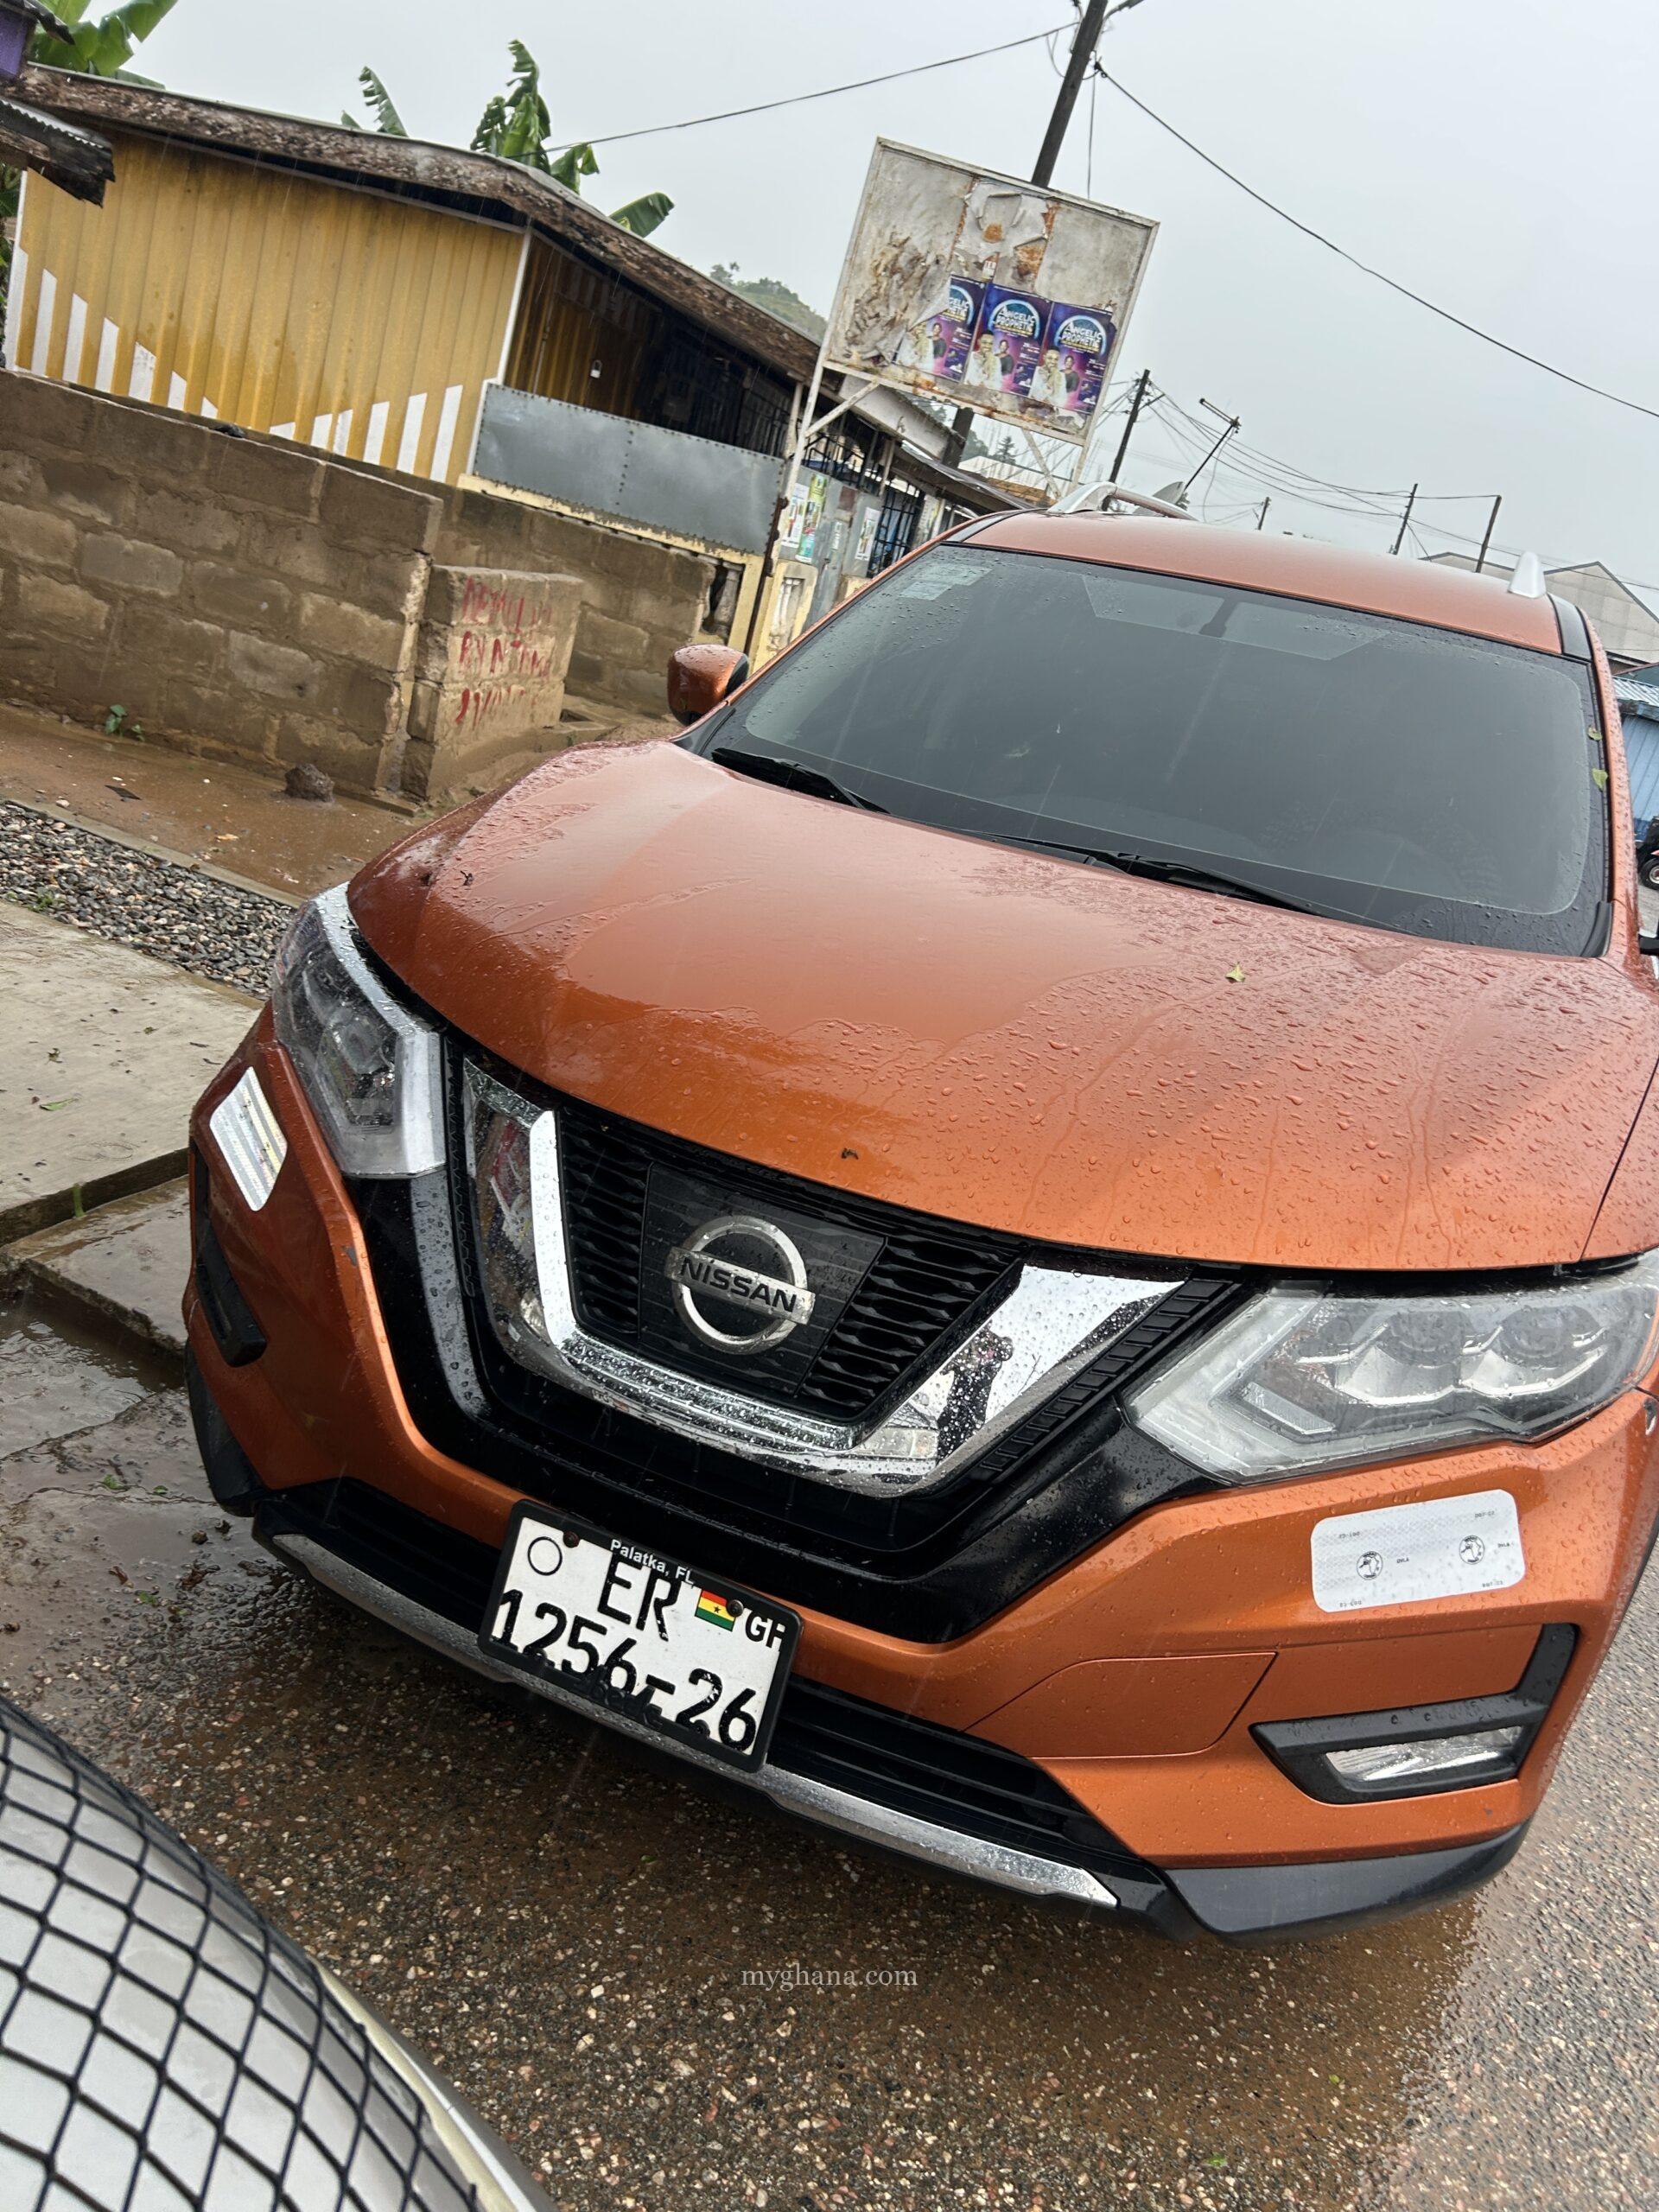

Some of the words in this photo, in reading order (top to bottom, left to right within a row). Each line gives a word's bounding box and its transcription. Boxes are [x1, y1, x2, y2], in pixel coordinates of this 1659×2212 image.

[997, 305, 1035, 323] ANGELIC
[1062, 321, 1102, 340] ANGELIC
[679, 1257, 797, 1313] NISSAN
[610, 1539, 670, 1577] Palatka,
[676, 1566, 695, 1585] FL
[598, 1553, 682, 1642] ER
[489, 1589, 757, 1752] 1256-26
